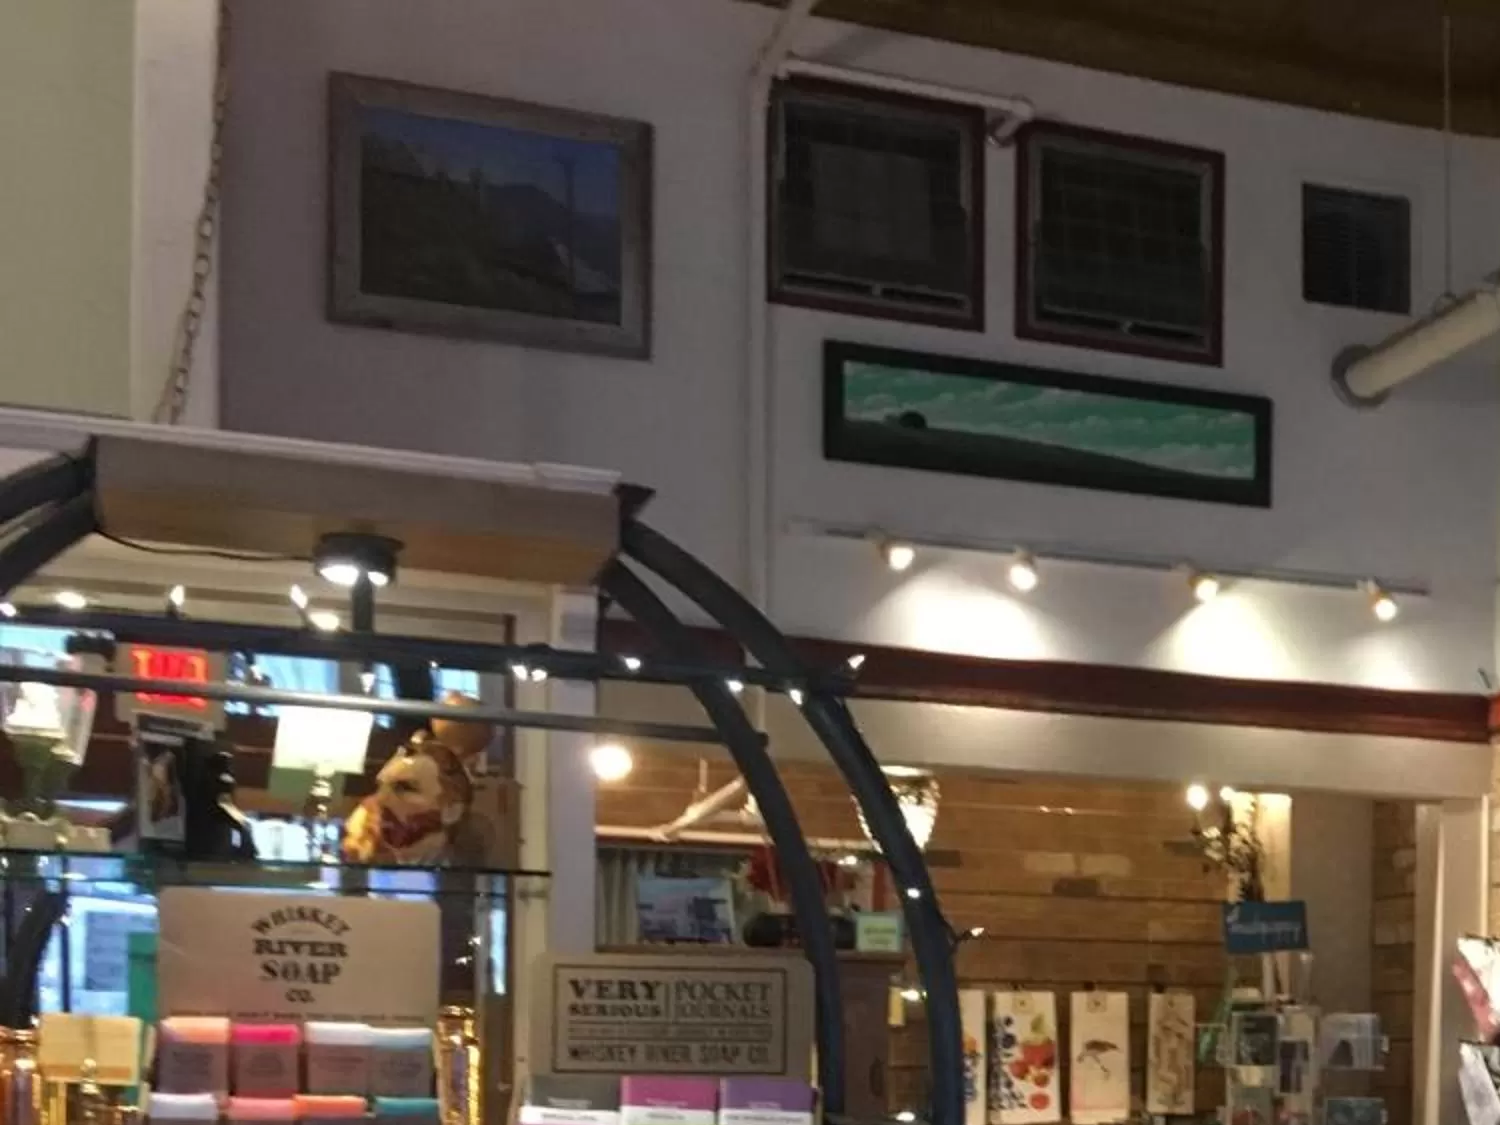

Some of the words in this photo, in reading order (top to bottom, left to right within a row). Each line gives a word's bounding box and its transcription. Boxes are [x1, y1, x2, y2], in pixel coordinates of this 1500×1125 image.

[251, 905, 351, 935] WHISKEY
[253, 938, 348, 958] RIVER
[260, 959, 341, 985] SOAP
[568, 979, 662, 1001] VERY
[674, 979, 773, 1002] POCKET
[568, 1003, 662, 1018] SERIOUS
[674, 1004, 772, 1019] JOURNALS
